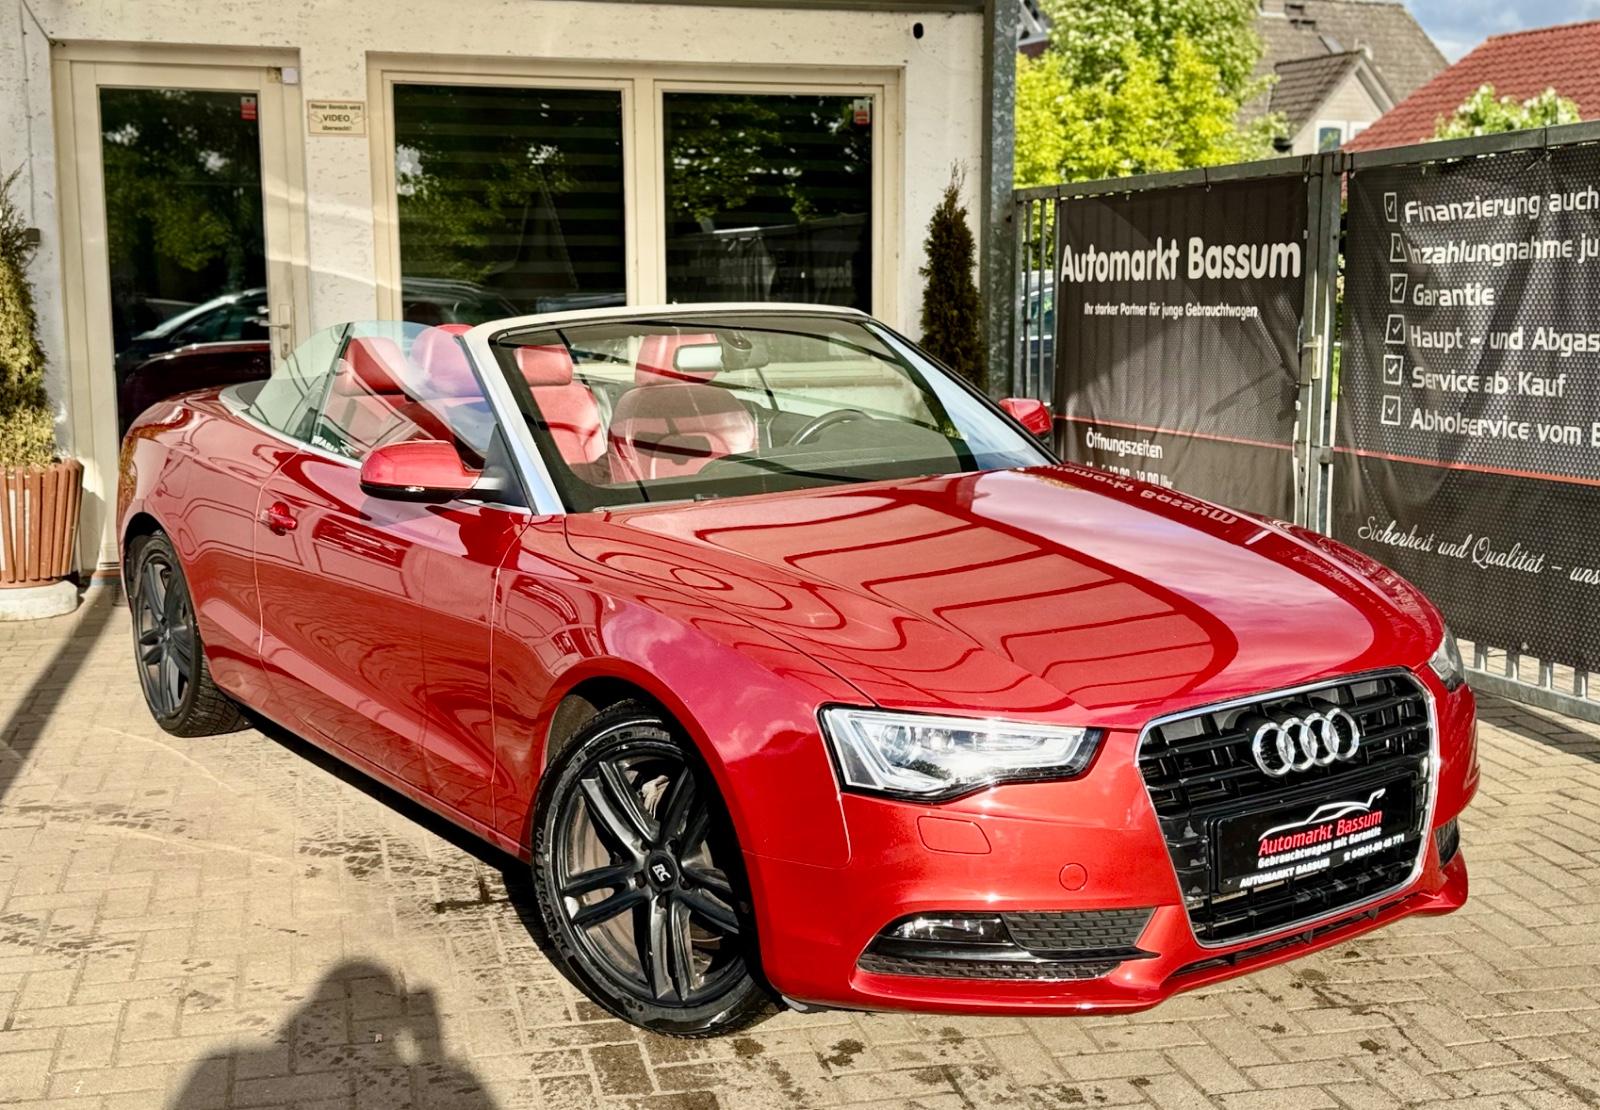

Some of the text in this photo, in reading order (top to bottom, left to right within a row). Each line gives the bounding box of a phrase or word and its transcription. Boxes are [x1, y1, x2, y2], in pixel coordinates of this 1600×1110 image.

[322, 114, 350, 122] VIDEO
[1405, 185, 1600, 223] Finanzierung auch
[1060, 236, 1301, 282] Automarkt Bassum
[1413, 282, 1496, 307] Garantie
[1084, 302, 1258, 321] Ihr starker Partner für junge Gebrauchtwagen
[1410, 325, 1463, 353] Haupt
[1490, 326, 1524, 350] und
[1531, 327, 1600, 357] Abgas
[1412, 366, 1567, 398] Service ab Kauf
[1086, 427, 1163, 459] Öffnungszeiten
[1409, 408, 1530, 440] Abholservice
[1537, 423, 1581, 446] vom
[1358, 516, 1434, 553] Sicherheit
[1438, 534, 1473, 560] und
[1472, 537, 1545, 574] Qualität
[1570, 566, 1600, 585] uns
[1257, 826, 1382, 869] Gebrauchtwagen mit Garantie
[1258, 810, 1383, 857] Automarkt Bassum
[1239, 867, 1295, 888] AUTOMARKT
[1296, 857, 1331, 875] BASSUM
